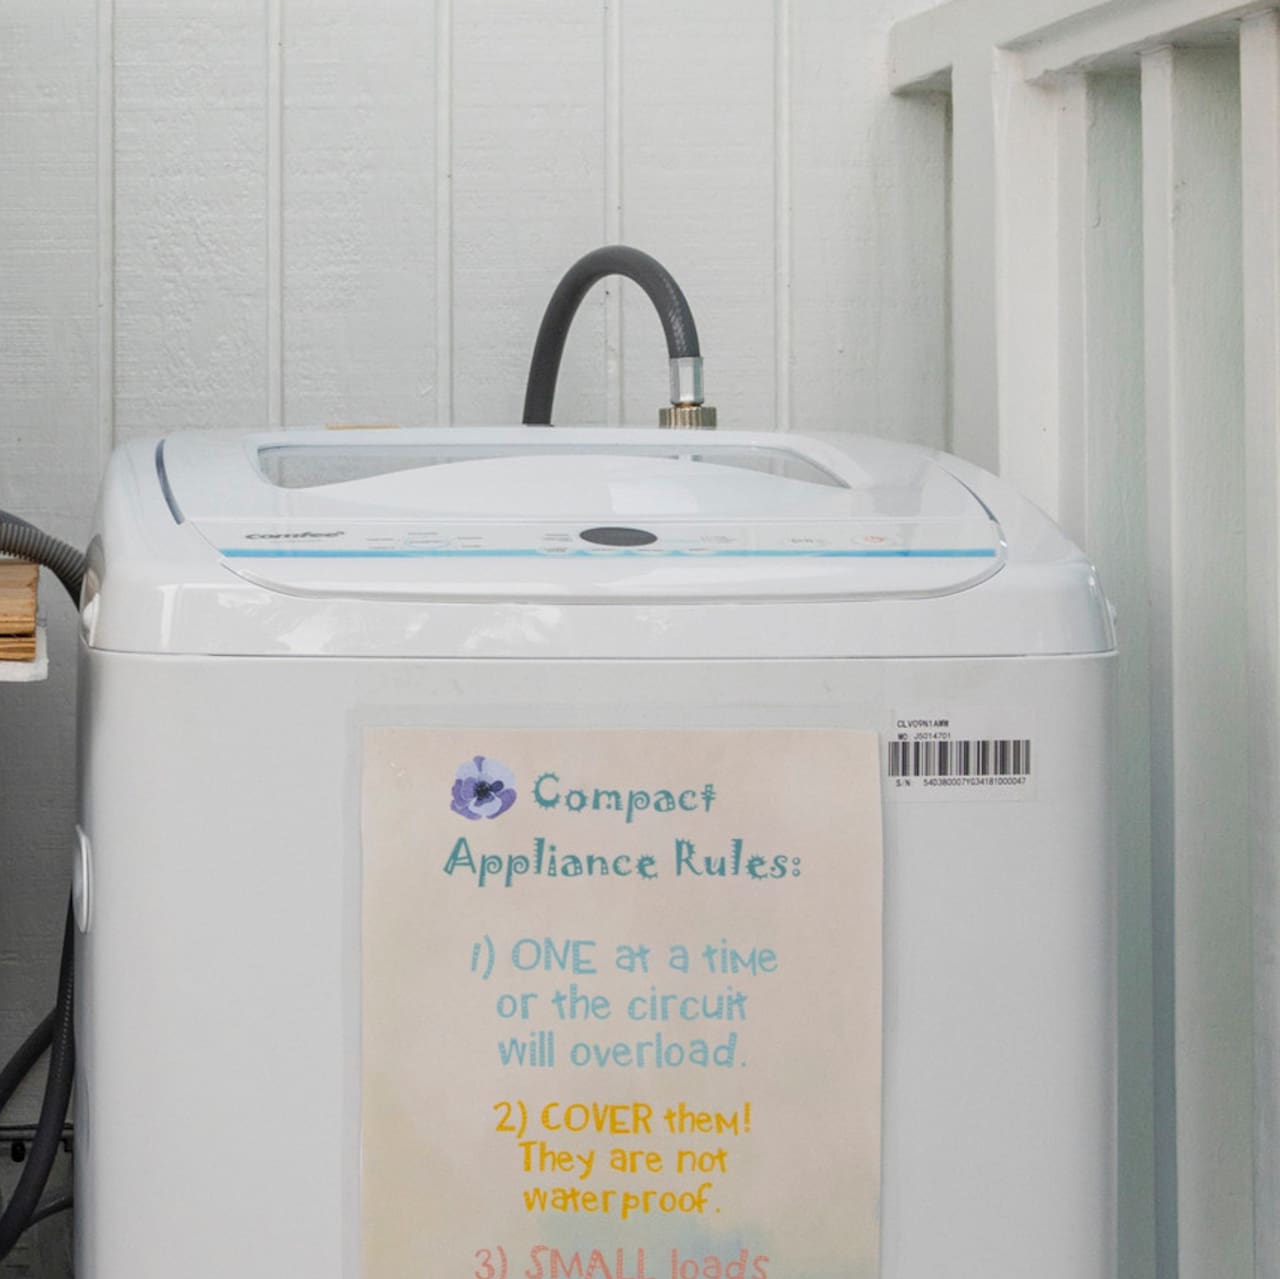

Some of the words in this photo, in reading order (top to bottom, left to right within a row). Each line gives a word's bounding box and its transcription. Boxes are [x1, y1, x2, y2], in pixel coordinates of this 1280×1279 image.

[532, 772, 717, 823] Compact
[443, 837, 658, 887] Appliance
[675, 839, 802, 879] Rules:
[471, 934, 495, 980] 1)
[511, 938, 597, 975] ONE
[615, 942, 651, 975] at
[669, 944, 689, 974] a
[702, 938, 779, 976] time
[497, 991, 537, 1020] or
[552, 984, 612, 1020] the
[627, 986, 748, 1021] circuit
[498, 1031, 554, 1068] will
[570, 1032, 747, 1068] overload.
[493, 1100, 528, 1139] 2)
[541, 1102, 652, 1134] COVER
[664, 1101, 752, 1136] them!
[519, 1141, 595, 1180] They
[609, 1146, 663, 1174] are
[677, 1147, 728, 1174] not
[523, 1182, 721, 1219] waterproof.
